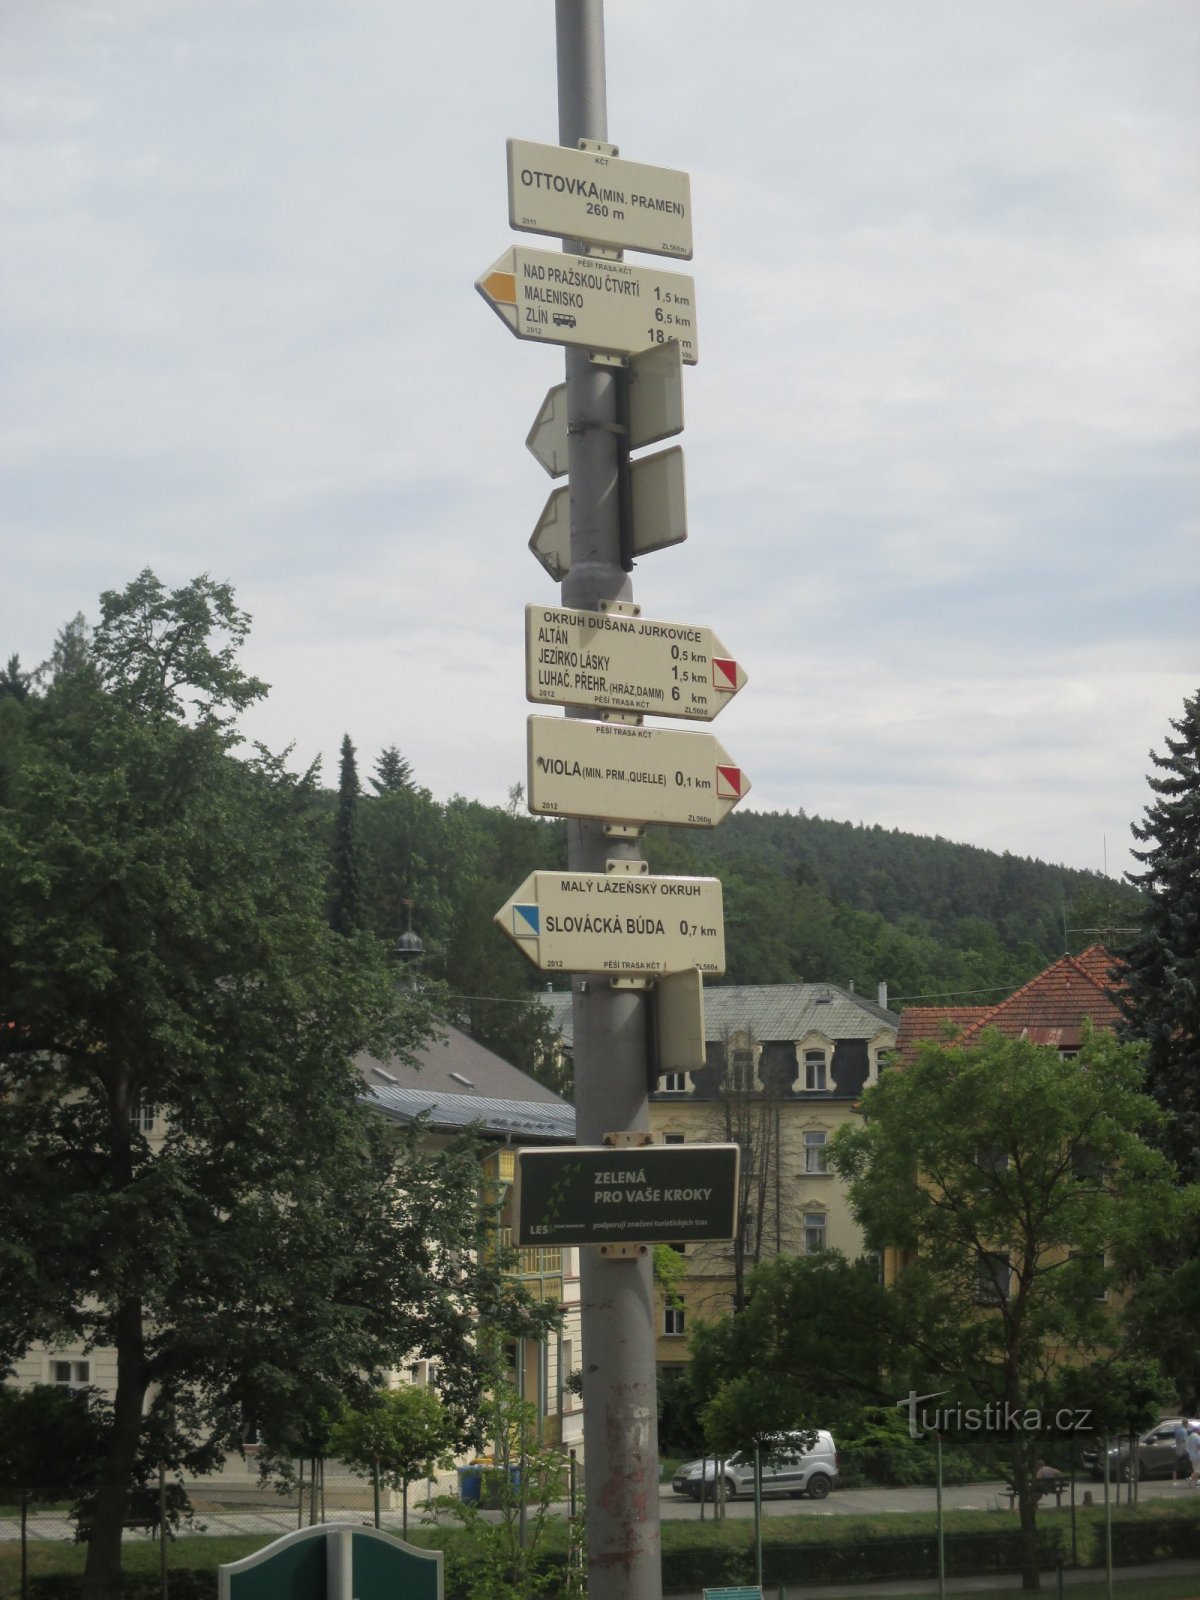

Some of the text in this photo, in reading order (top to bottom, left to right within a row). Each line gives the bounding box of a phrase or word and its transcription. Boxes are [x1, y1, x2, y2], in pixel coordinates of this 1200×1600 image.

[595, 156, 609, 166] KČT
[586, 202, 625, 220] 260 m
[631, 194, 685, 218] PRAMEN)
[522, 217, 537, 226] 2011
[595, 263, 617, 272] TRASA
[619, 267, 632, 275] KČT
[524, 264, 545, 280] NAD
[548, 268, 602, 290] PRAŽSKOU
[605, 275, 640, 297] ČTVRTÍ
[674, 294, 689, 305] km
[524, 285, 584, 308] MALENISKO
[675, 315, 691, 327] km
[526, 306, 548, 324] ZLÍN
[526, 326, 542, 334] 2012
[544, 611, 702, 642] OKRUH DUŠANA JURKOVIČE
[538, 625, 707, 663] ALTÁN 0,5 km
[539, 646, 707, 684] JEZÍRKO LÁSKY 1,5 km
[539, 669, 572, 688] LUHAČ.
[672, 686, 680, 701] 6
[692, 693, 707, 704] km
[539, 689, 555, 697] 2012
[612, 698, 634, 707] TRASA
[614, 728, 637, 736] TRASA
[675, 771, 691, 787] 0,1
[696, 778, 711, 788] km
[542, 802, 558, 810] 2012
[561, 879, 701, 896] MALÝ LÁZEŇSKÝ OKRUH
[546, 914, 716, 937] SLOVÁCKÁ BÚDA 0,7 km
[646, 961, 661, 969] KČT
[594, 1169, 646, 1184] ZELENÁ
[594, 1187, 712, 1203] PRO VAŠE KROKY
[593, 1221, 626, 1230] podporují
[627, 1220, 653, 1228] značení
[654, 1219, 693, 1228] turistických
